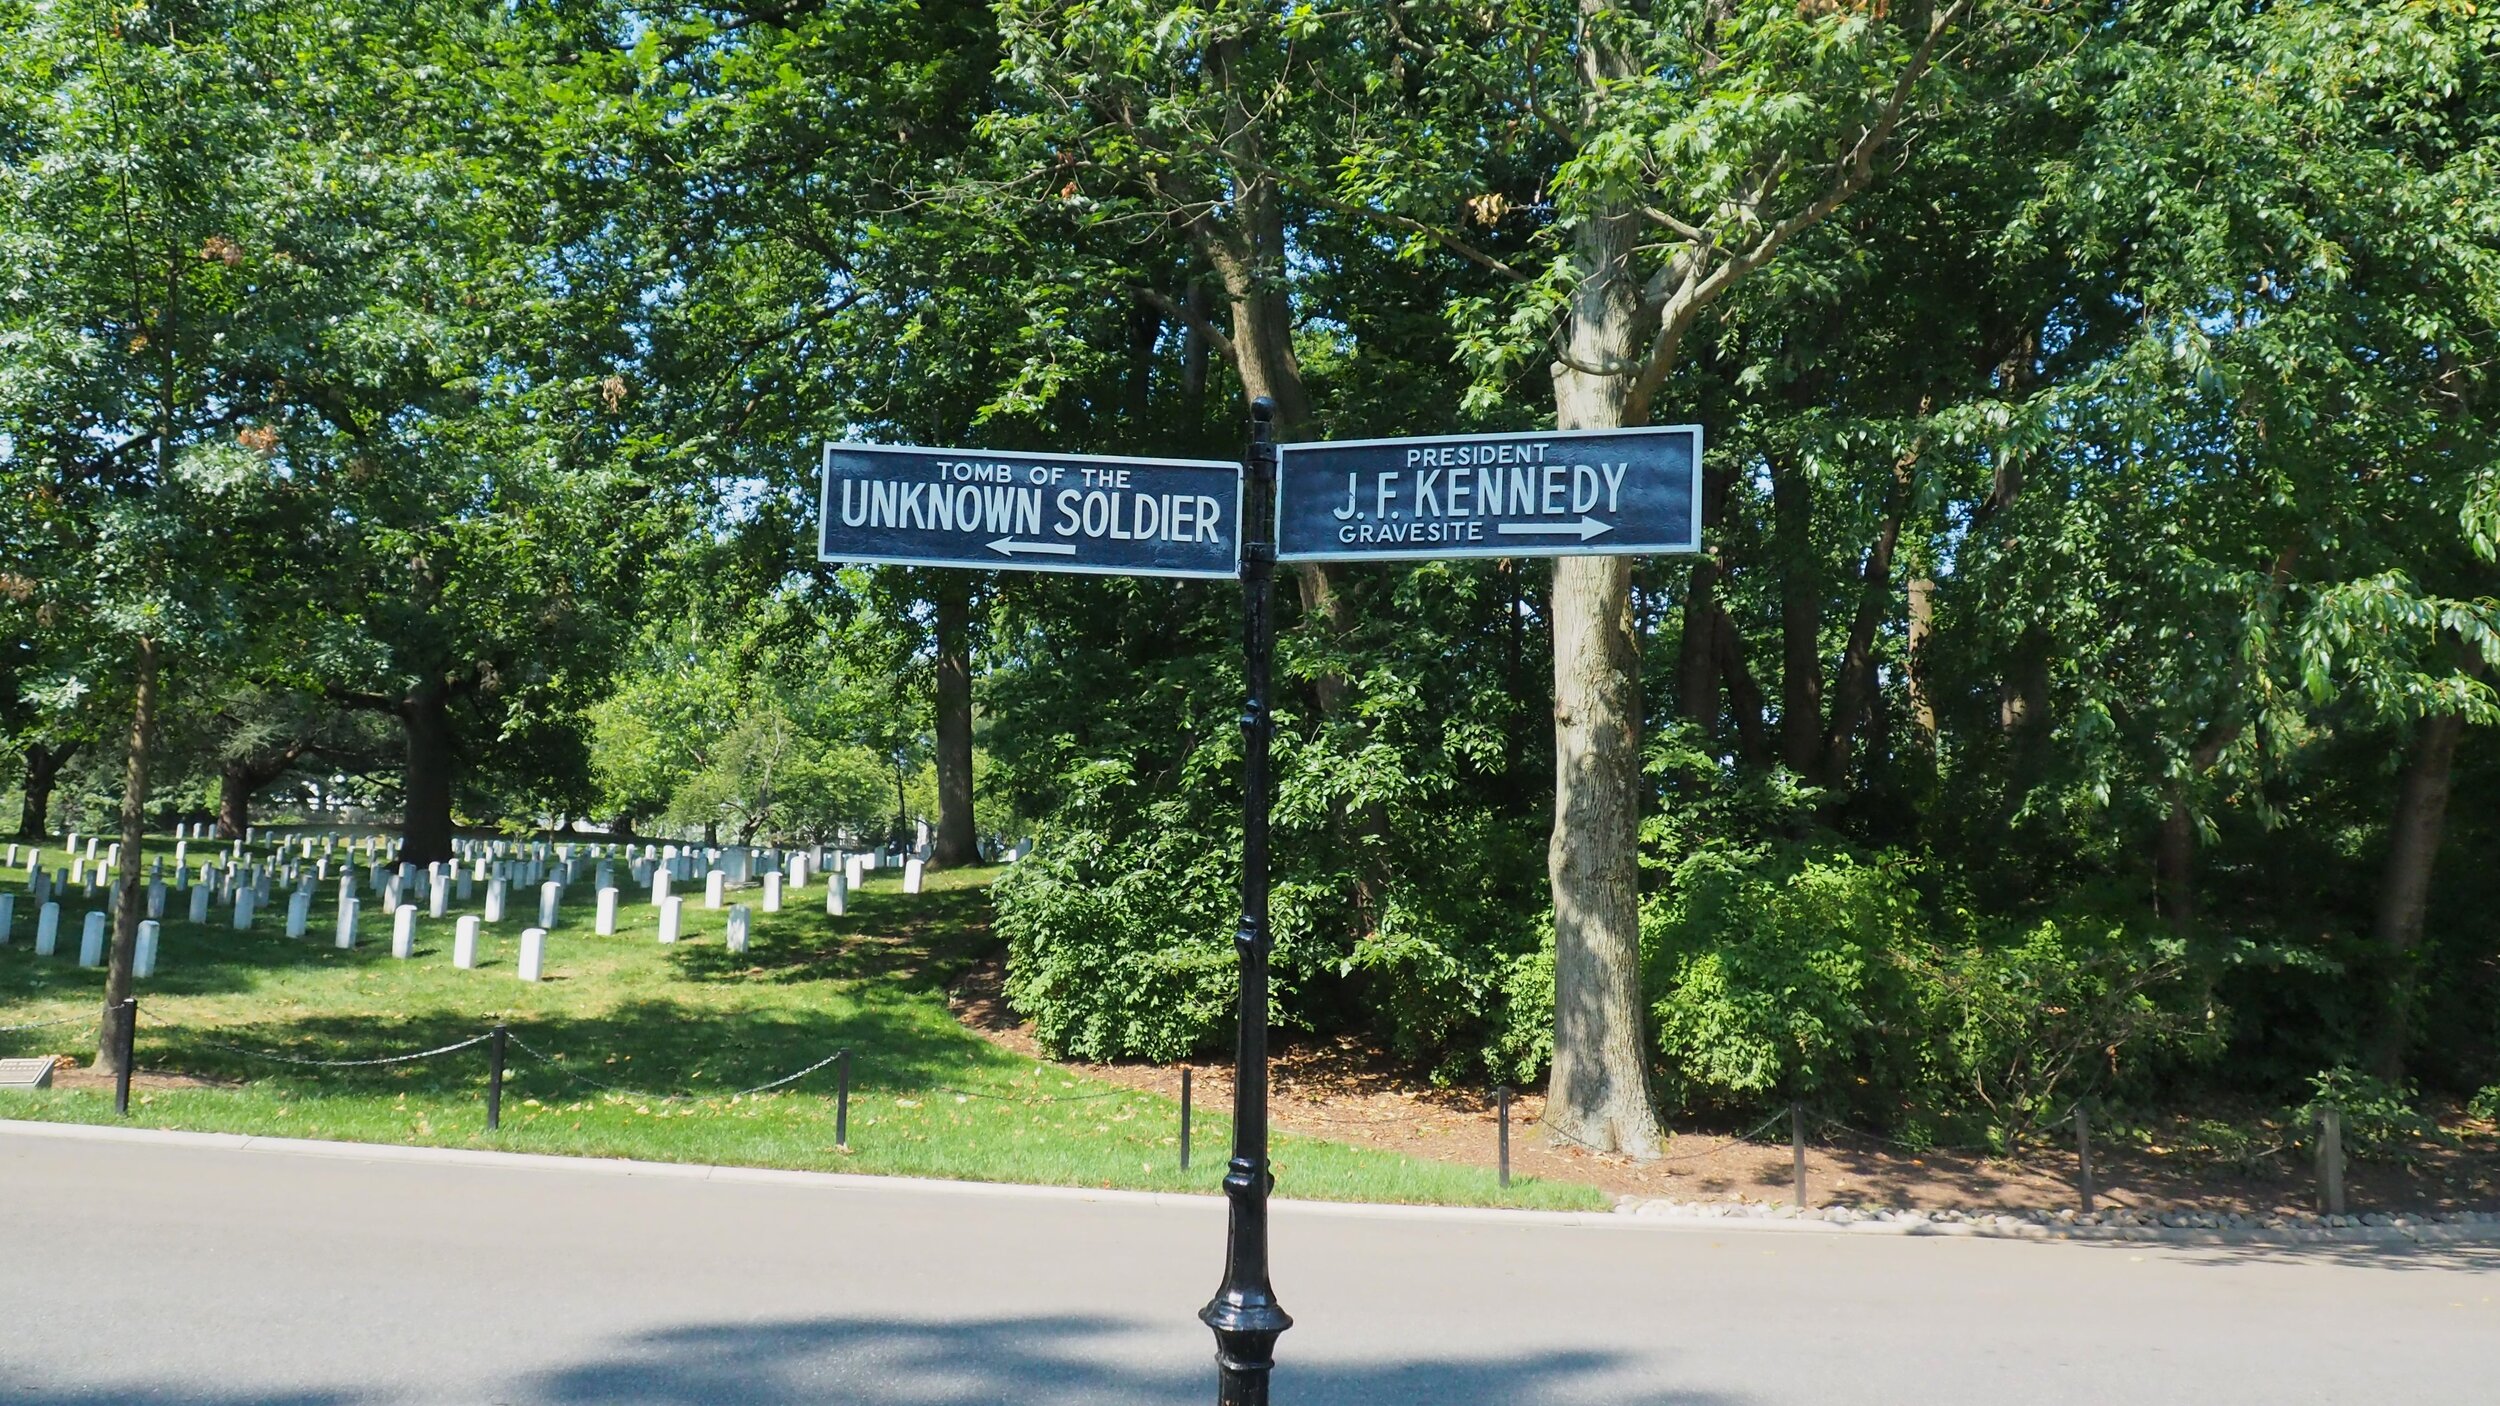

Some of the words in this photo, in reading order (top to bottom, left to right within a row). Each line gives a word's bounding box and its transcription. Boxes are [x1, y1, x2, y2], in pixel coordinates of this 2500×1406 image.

[1408, 443, 1549, 468] PRESIDENT
[937, 461, 1012, 484] TOMB
[1029, 466, 1065, 486] OF
[1081, 468, 1131, 489] THE
[1415, 463, 1628, 518] KENNEDY
[841, 479, 1042, 536] UNKNOWN
[1053, 489, 1221, 544] SOLDIER
[1338, 521, 1484, 544] GRAVESITE
